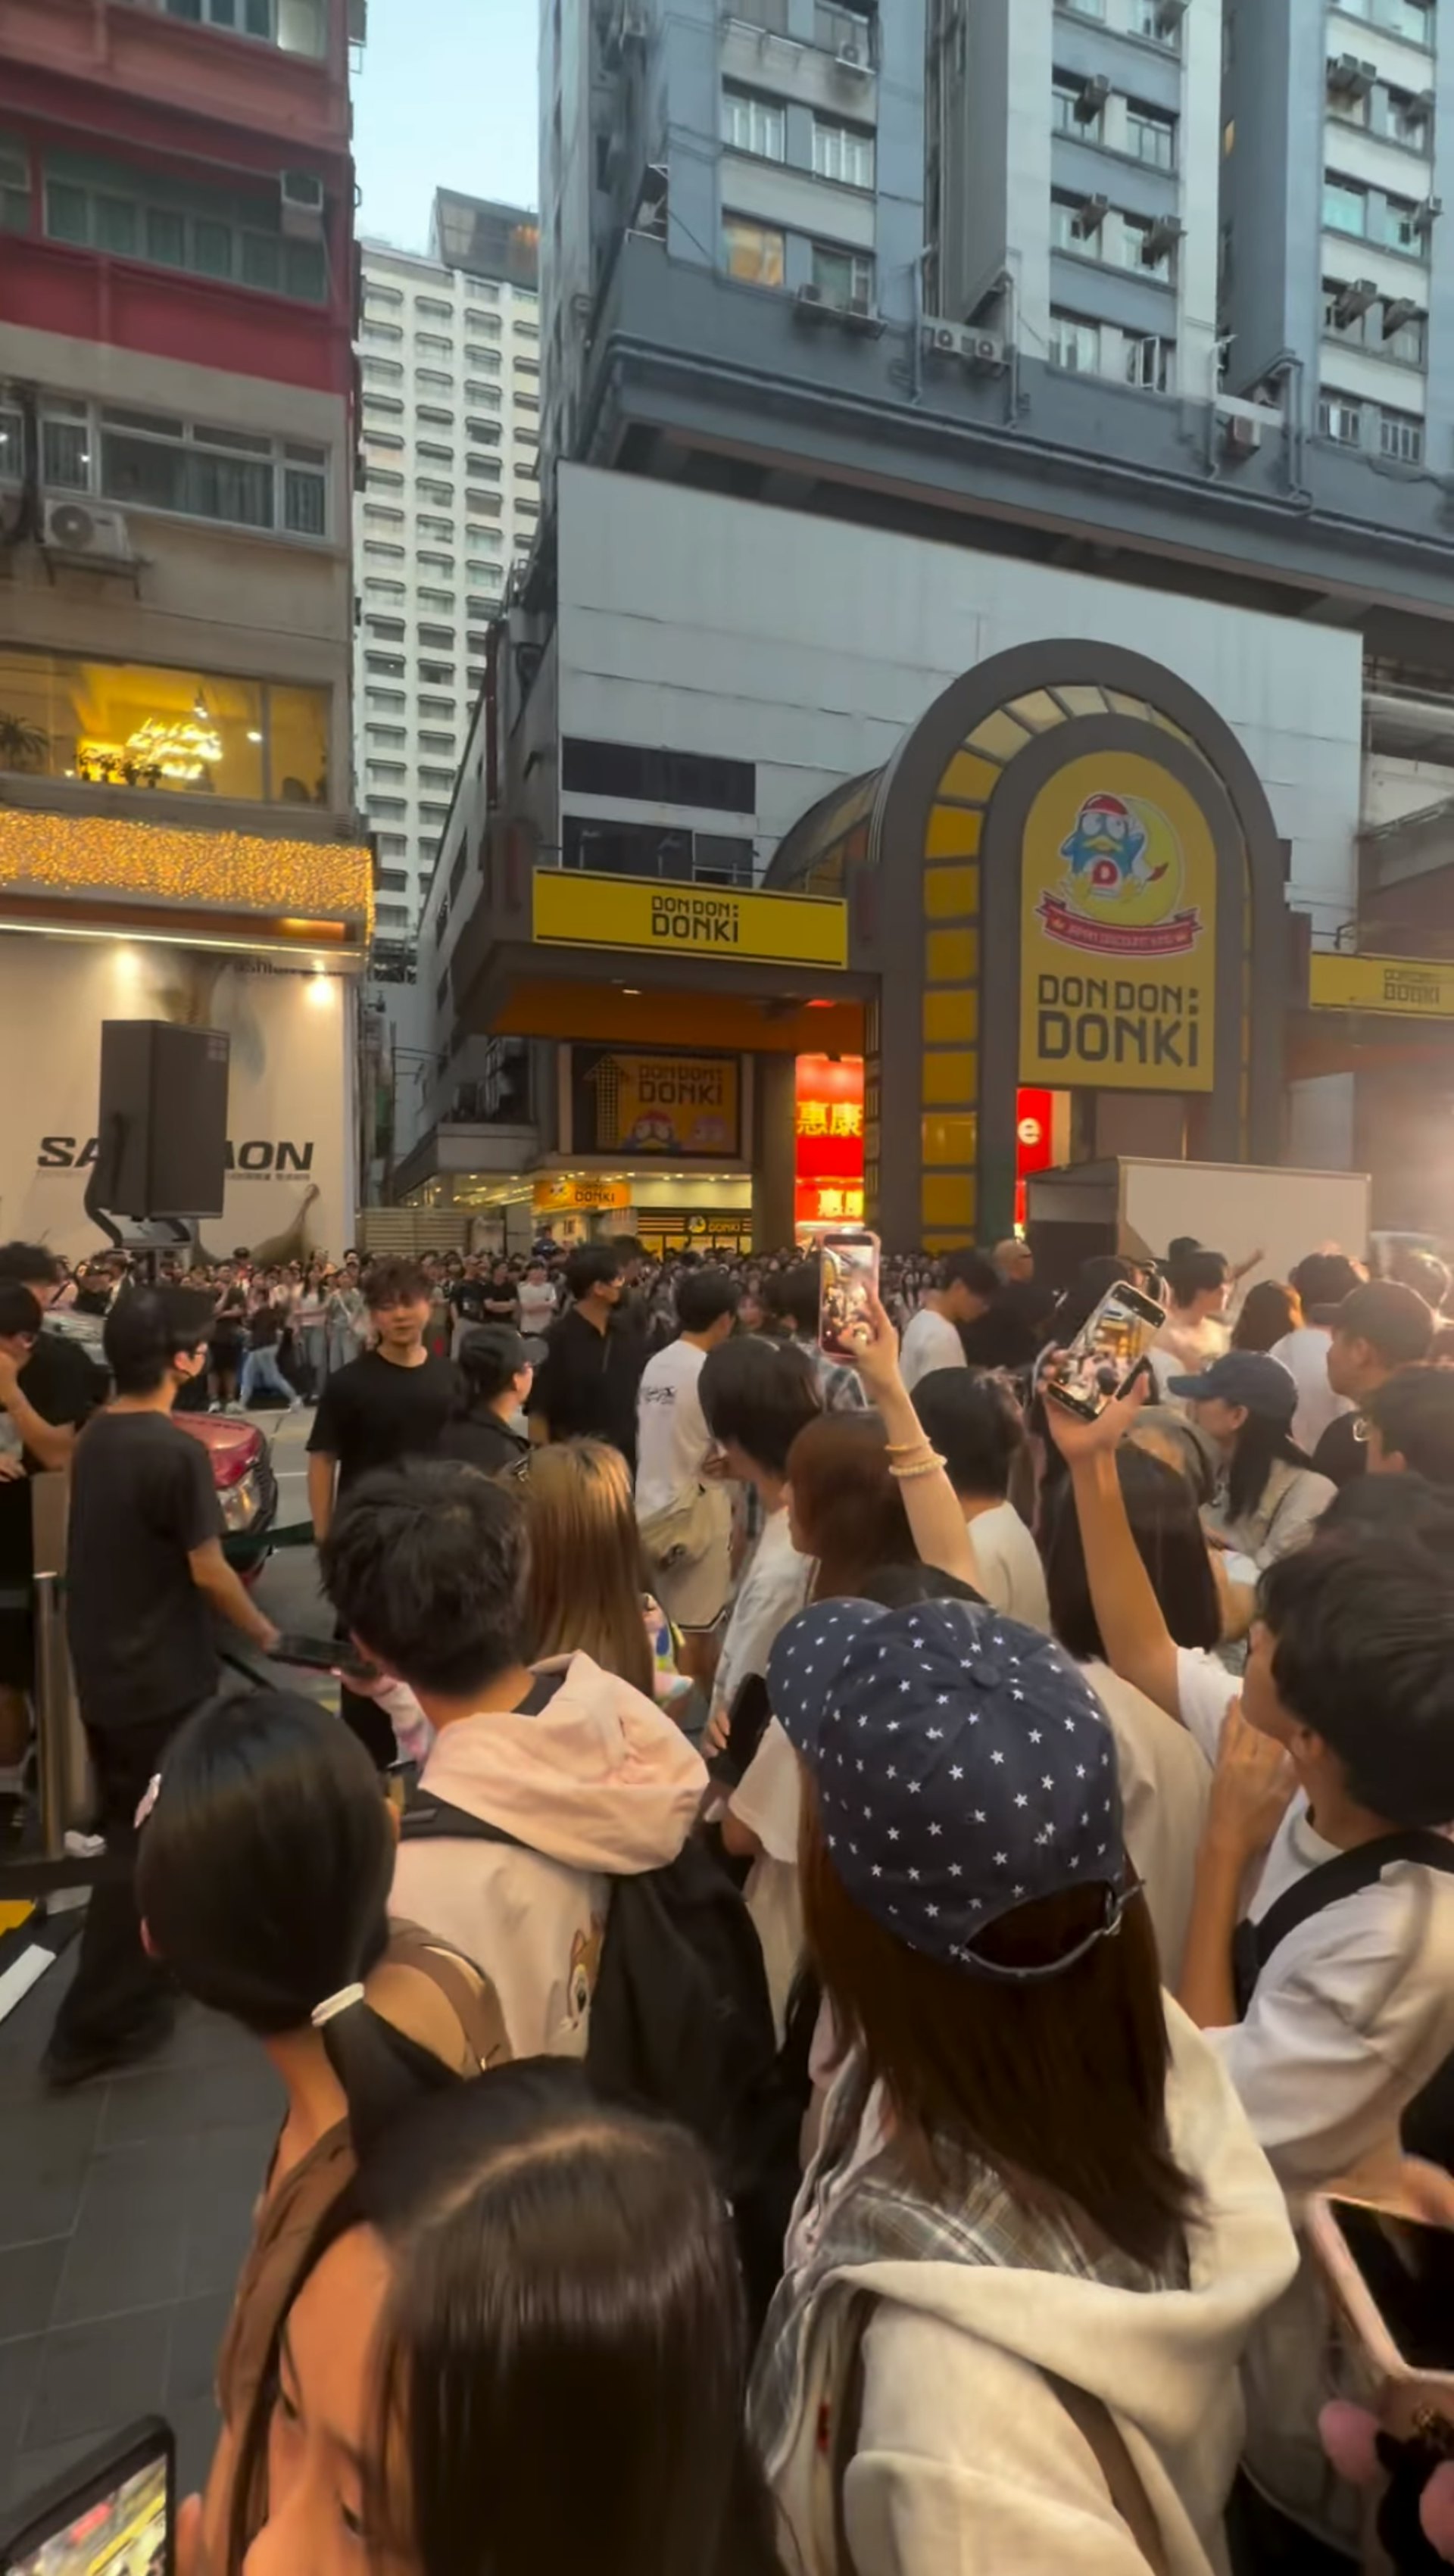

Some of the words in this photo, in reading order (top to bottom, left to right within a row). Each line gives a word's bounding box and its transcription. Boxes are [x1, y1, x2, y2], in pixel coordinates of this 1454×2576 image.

[652, 896, 689, 913] DON
[652, 913, 738, 943] DONKI
[1038, 975, 1107, 1009] DON
[1038, 1010, 1199, 1067] DONKI
[639, 1081, 723, 1106] DONKI
[797, 1101, 863, 1136] 惠康
